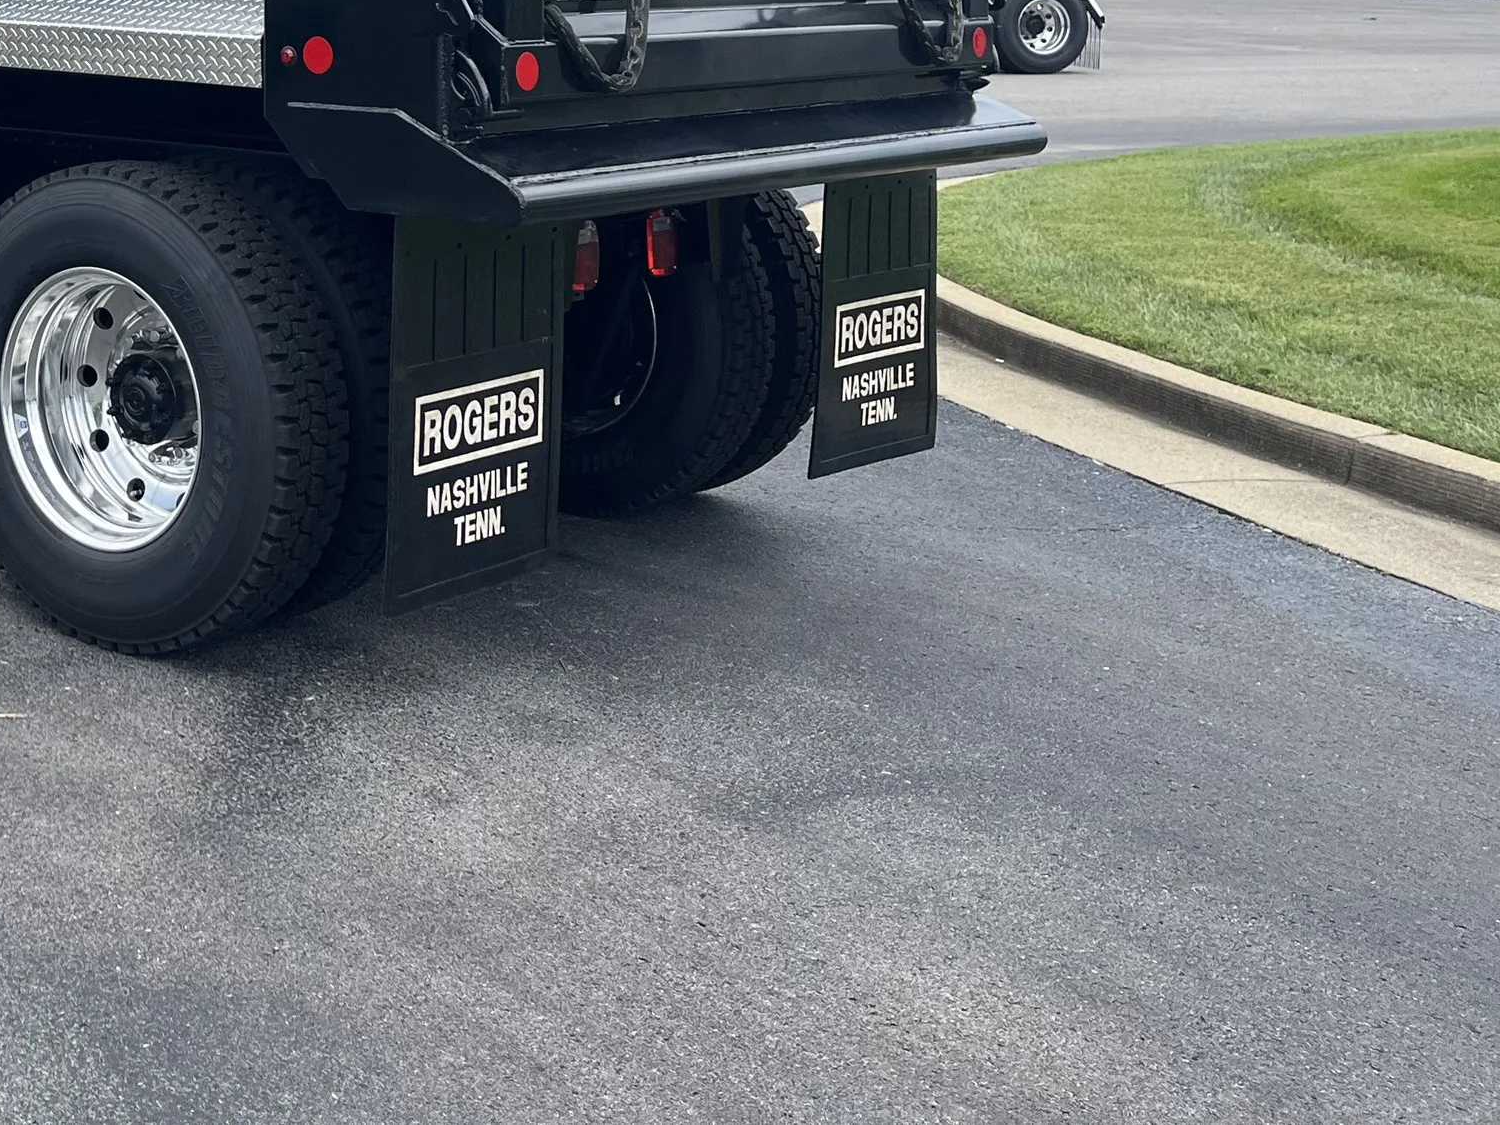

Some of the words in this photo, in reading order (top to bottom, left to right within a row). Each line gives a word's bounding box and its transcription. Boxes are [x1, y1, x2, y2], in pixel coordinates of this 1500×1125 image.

[841, 303, 918, 353] ROGERS
[842, 362, 914, 402] NASHVILLE
[423, 387, 535, 457] ROGERS
[861, 396, 898, 426] TENN.
[426, 461, 528, 517] NASHVILLE
[454, 505, 505, 546] TENN.
